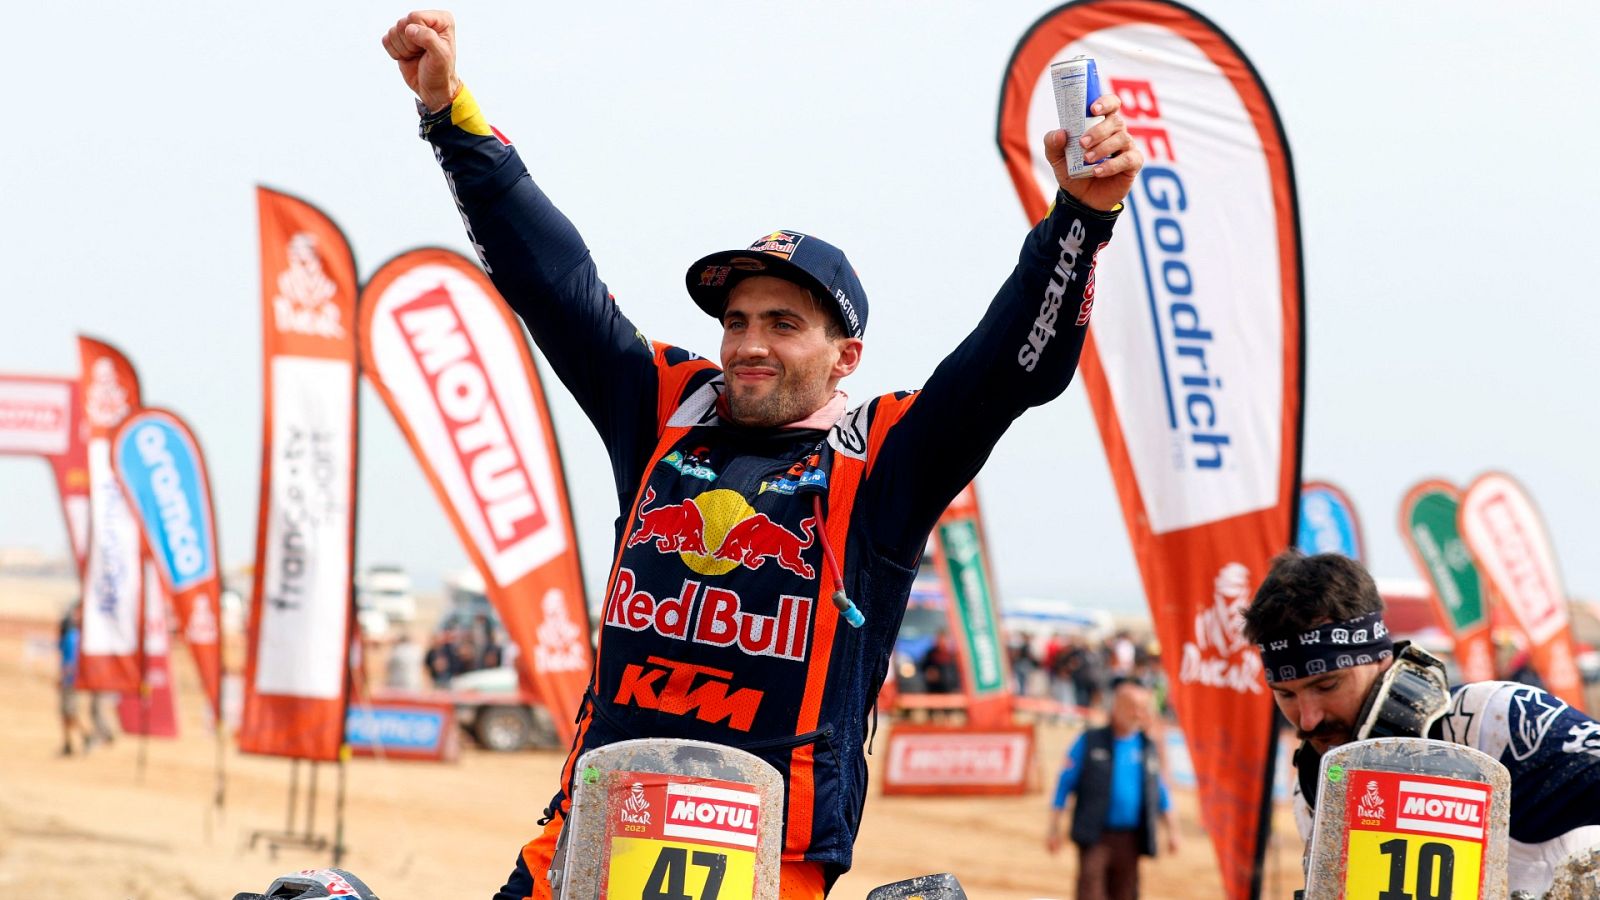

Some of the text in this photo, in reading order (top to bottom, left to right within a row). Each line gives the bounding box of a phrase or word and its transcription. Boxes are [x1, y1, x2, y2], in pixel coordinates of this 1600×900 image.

[1017, 217, 1086, 373] alpinestars
[1109, 78, 1230, 469] BFGoodrich
[835, 288, 860, 331] FACTORY
[400, 304, 540, 542] MOTUL
[135, 424, 204, 576] aramco
[605, 567, 813, 662] Red Bull
[613, 655, 764, 732] KTM
[620, 809, 652, 826] DAKAR
[624, 824, 647, 833] 2023
[670, 800, 755, 830] MOTUL
[1357, 804, 1386, 820] DAKAR
[1360, 819, 1381, 827] 2023
[1403, 796, 1481, 823] MOTUL
[642, 847, 728, 900] 47
[1379, 838, 1455, 900] 10
